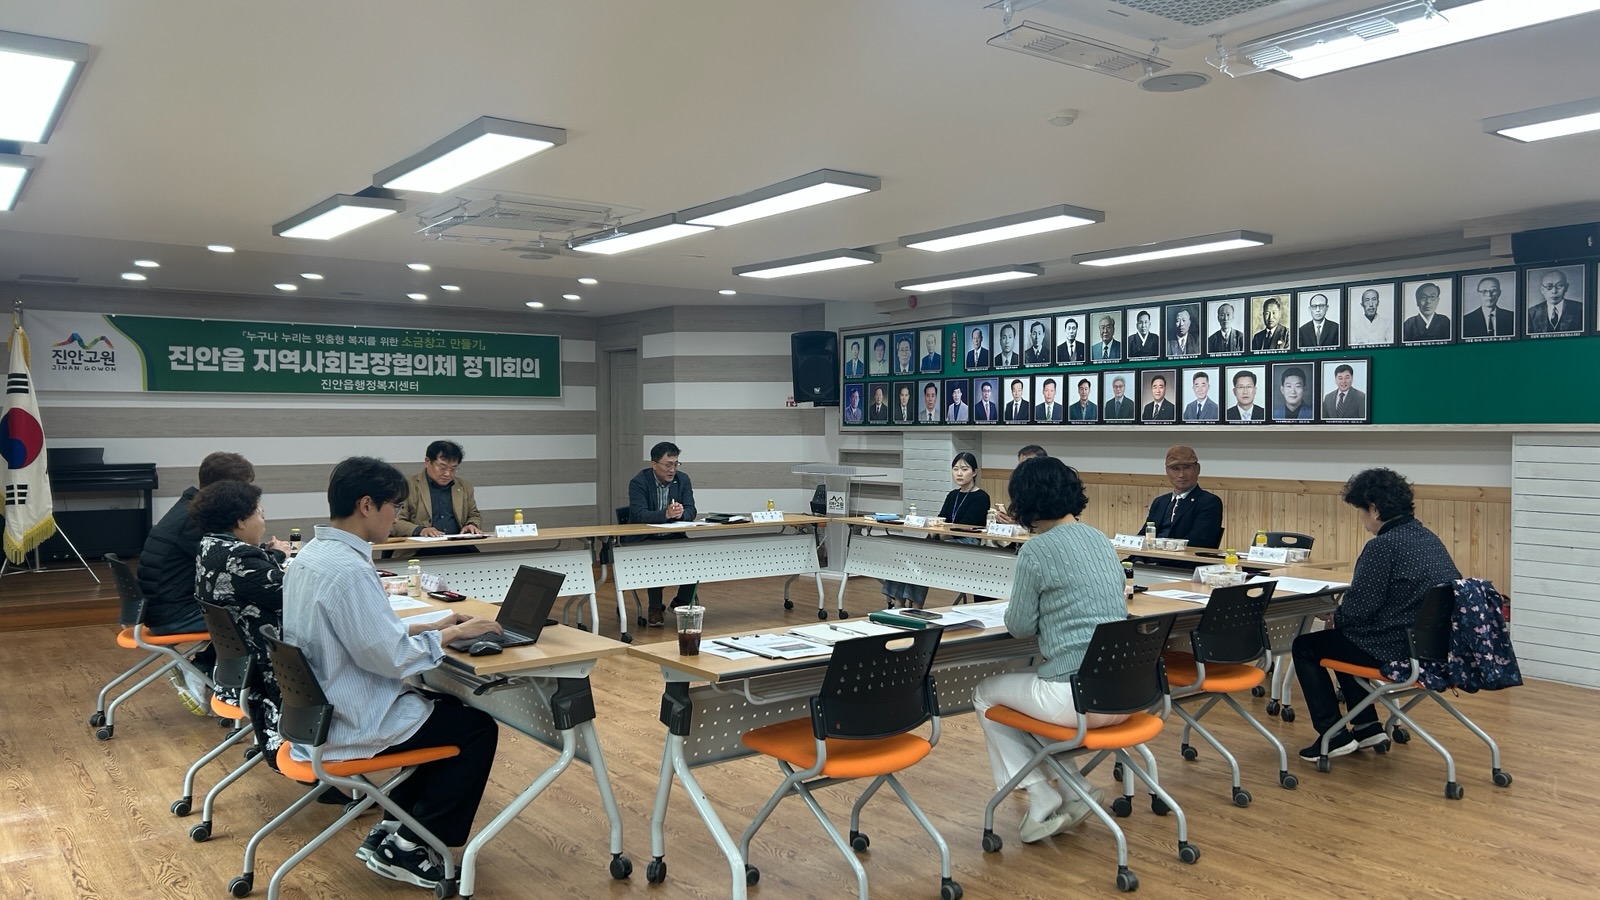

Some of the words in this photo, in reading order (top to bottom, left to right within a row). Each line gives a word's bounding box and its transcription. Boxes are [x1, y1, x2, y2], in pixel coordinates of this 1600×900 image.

[281, 333, 312, 344] 누리는
[315, 334, 345, 345] 맞춤형
[348, 335, 376, 346] 복지를
[380, 336, 399, 347] 위한
[401, 336, 447, 349] 소금창고
[52, 349, 115, 366] 진안고원
[168, 345, 246, 373] 진안읍
[252, 348, 457, 377] 지역사회보장협의체
[462, 355, 541, 379] 정기회의
[320, 379, 420, 392] 진안읍행정복지센터
